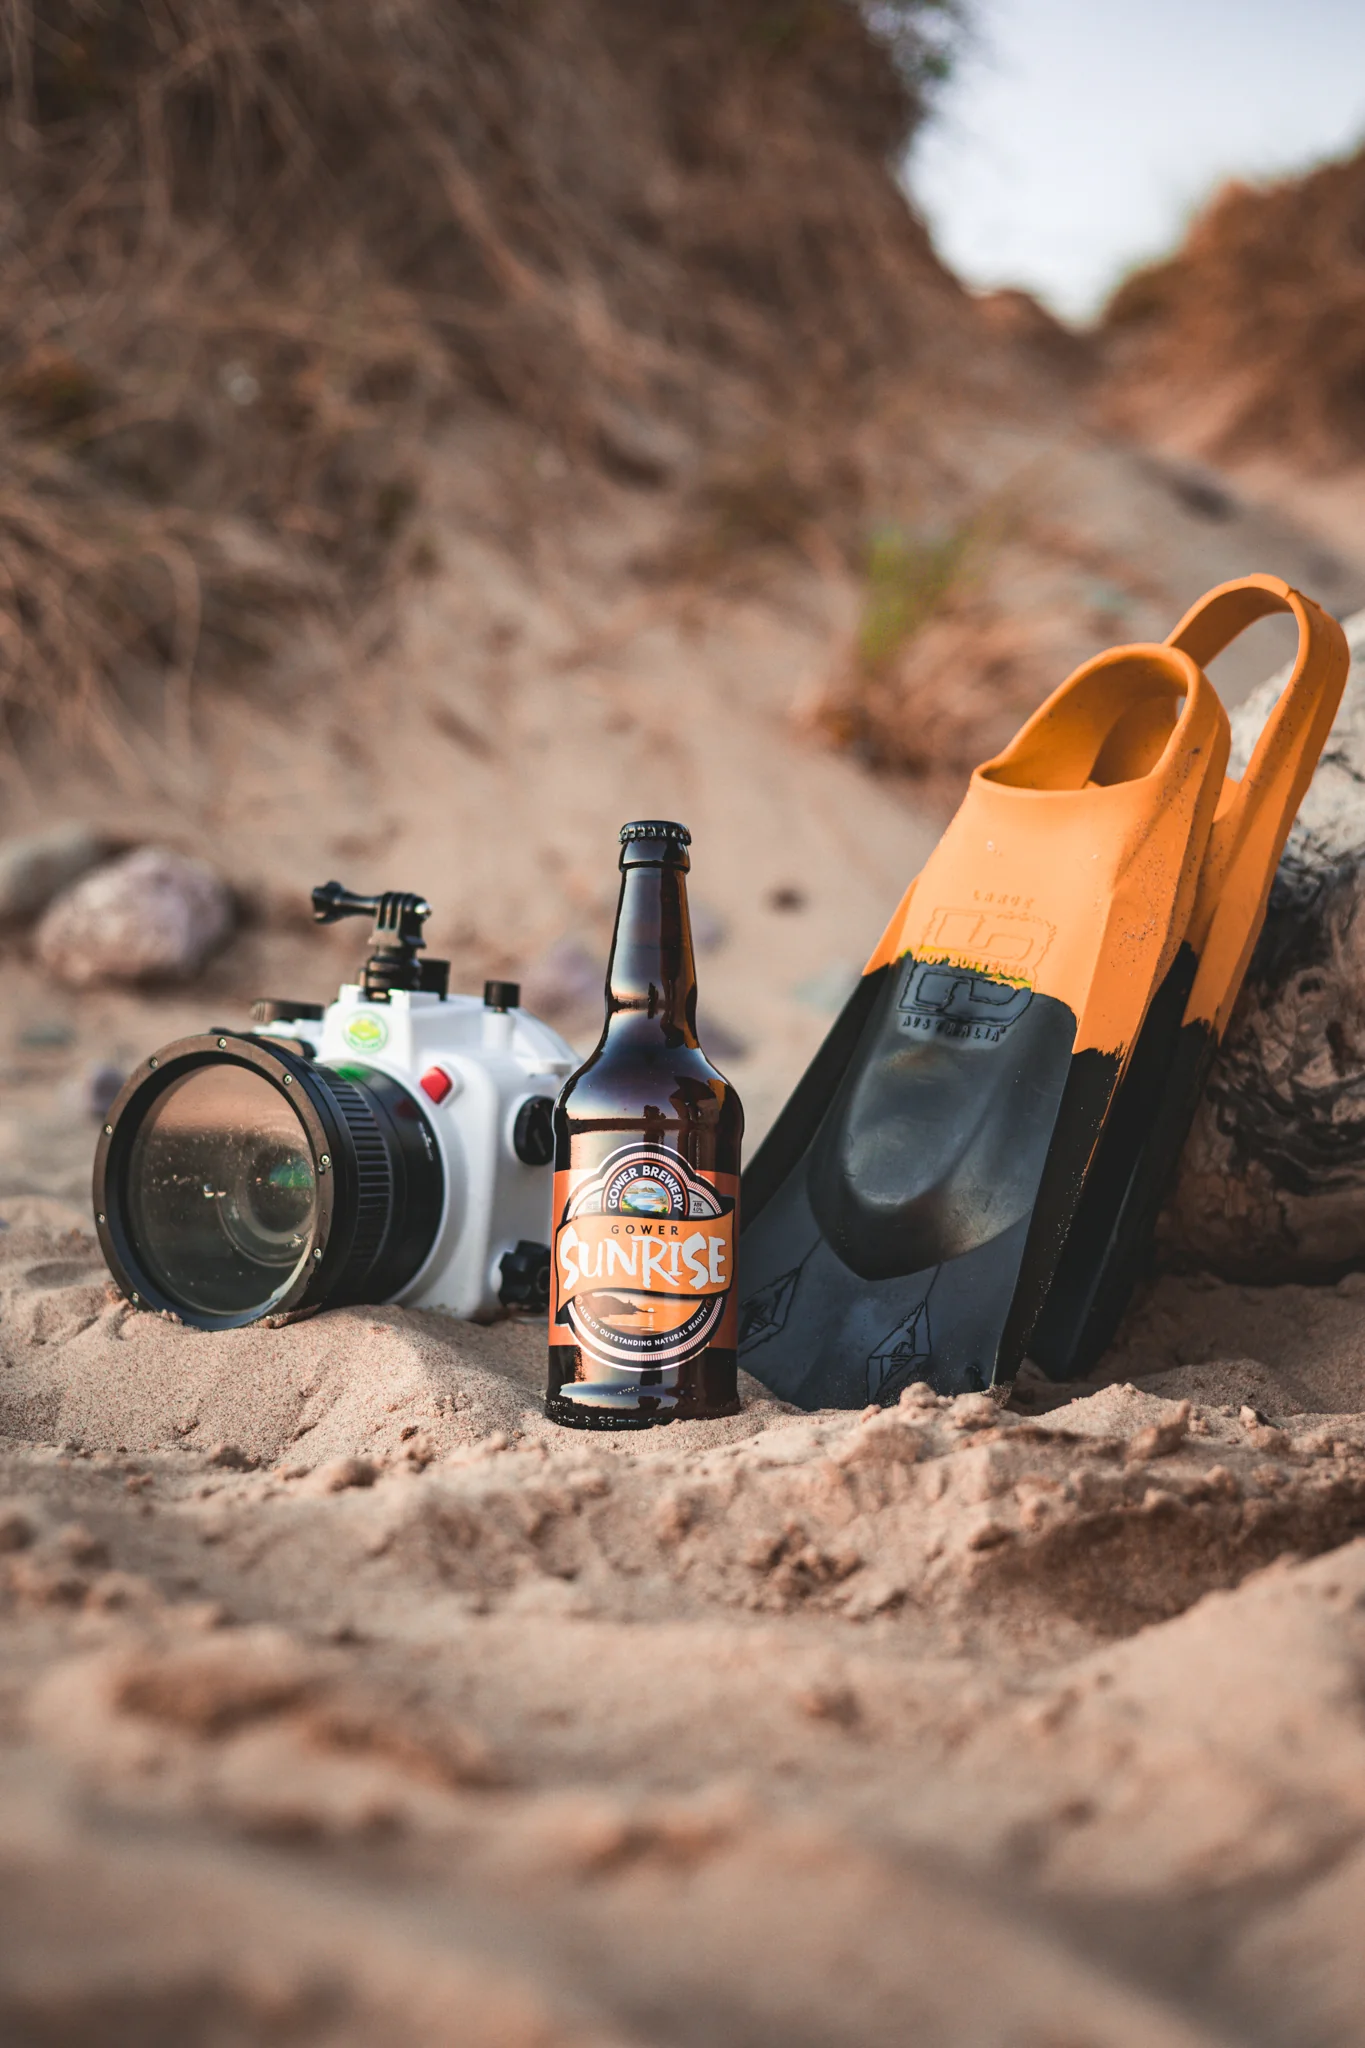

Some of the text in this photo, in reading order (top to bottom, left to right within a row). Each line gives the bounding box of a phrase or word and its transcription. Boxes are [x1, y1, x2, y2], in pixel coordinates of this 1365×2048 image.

[902, 1015, 1001, 1042] AUSTRALIA
[608, 1165, 684, 1211] GOWER BREWERY
[611, 1224, 679, 1236] GOWER
[560, 1225, 726, 1290] SUNRISE
[579, 1306, 708, 1346] ALES OF OUTSTANDING NATURAL BEAUTY
